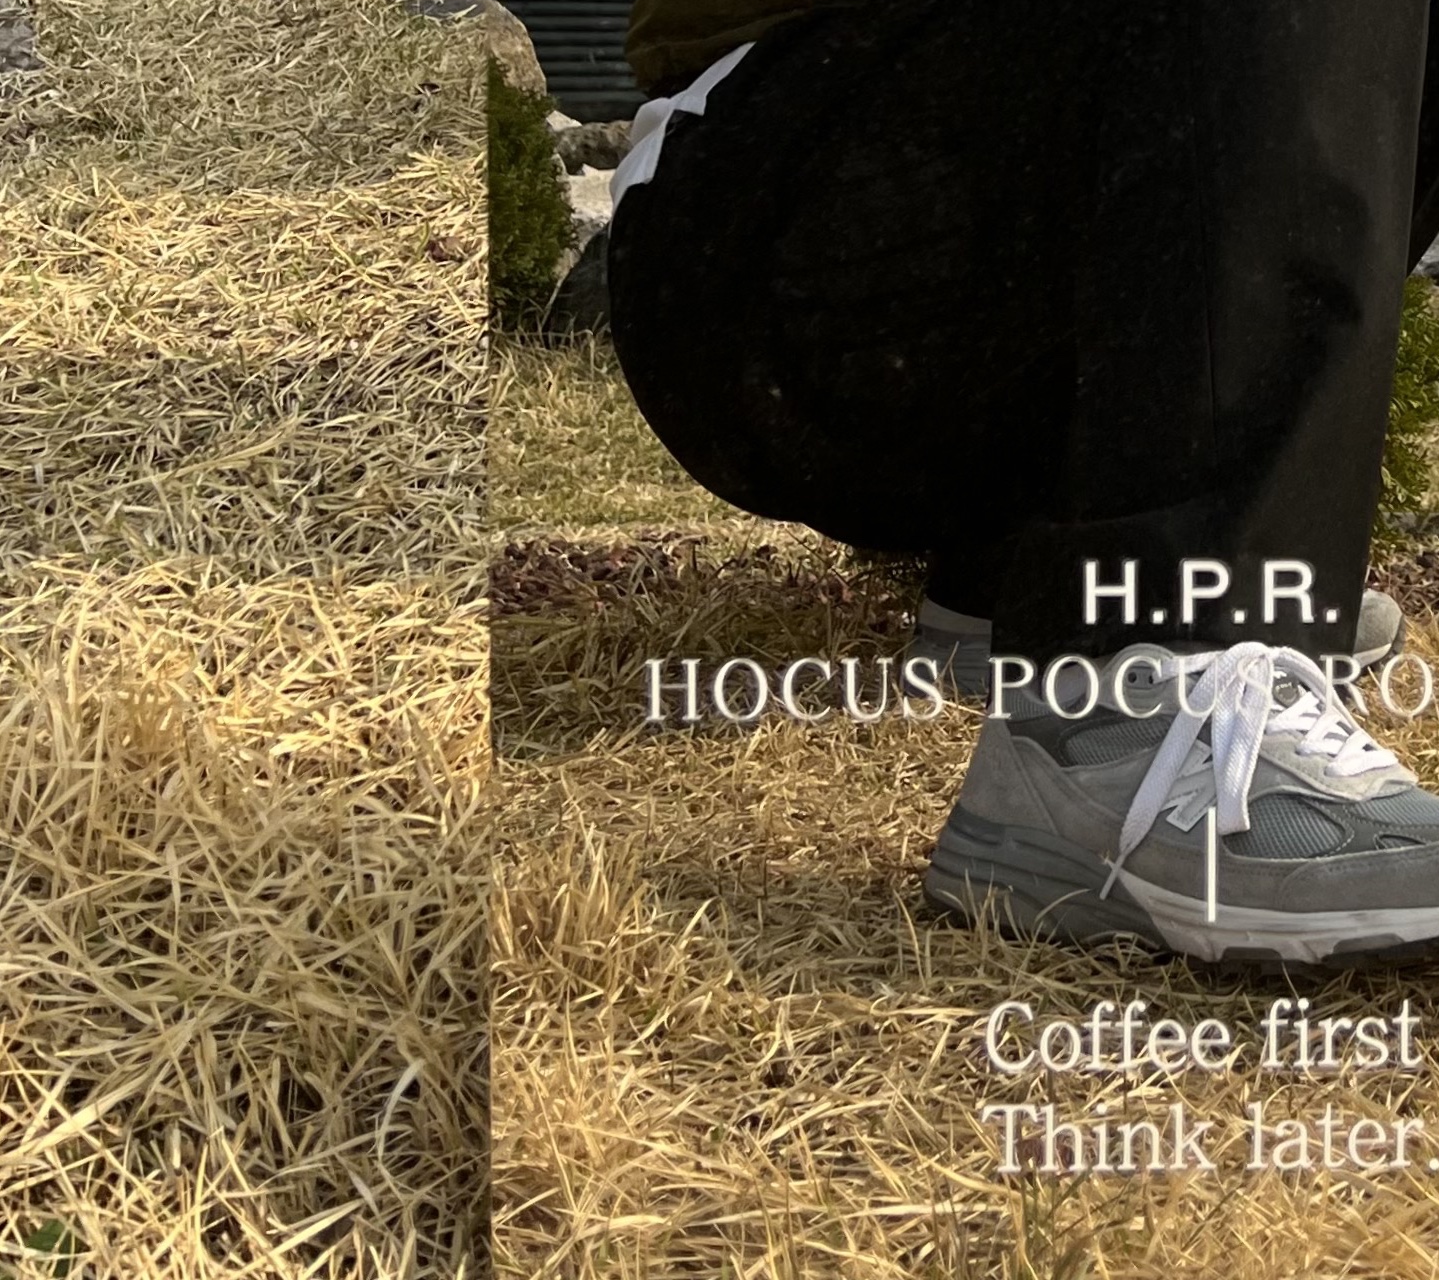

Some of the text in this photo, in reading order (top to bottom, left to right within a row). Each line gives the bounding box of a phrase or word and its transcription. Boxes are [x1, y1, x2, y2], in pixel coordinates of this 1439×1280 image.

[1083, 559, 1338, 625] H.P.R.
[645, 656, 944, 722] HOCUS
[984, 997, 1423, 1074] Coffee first
[982, 1101, 1217, 1174] Think
